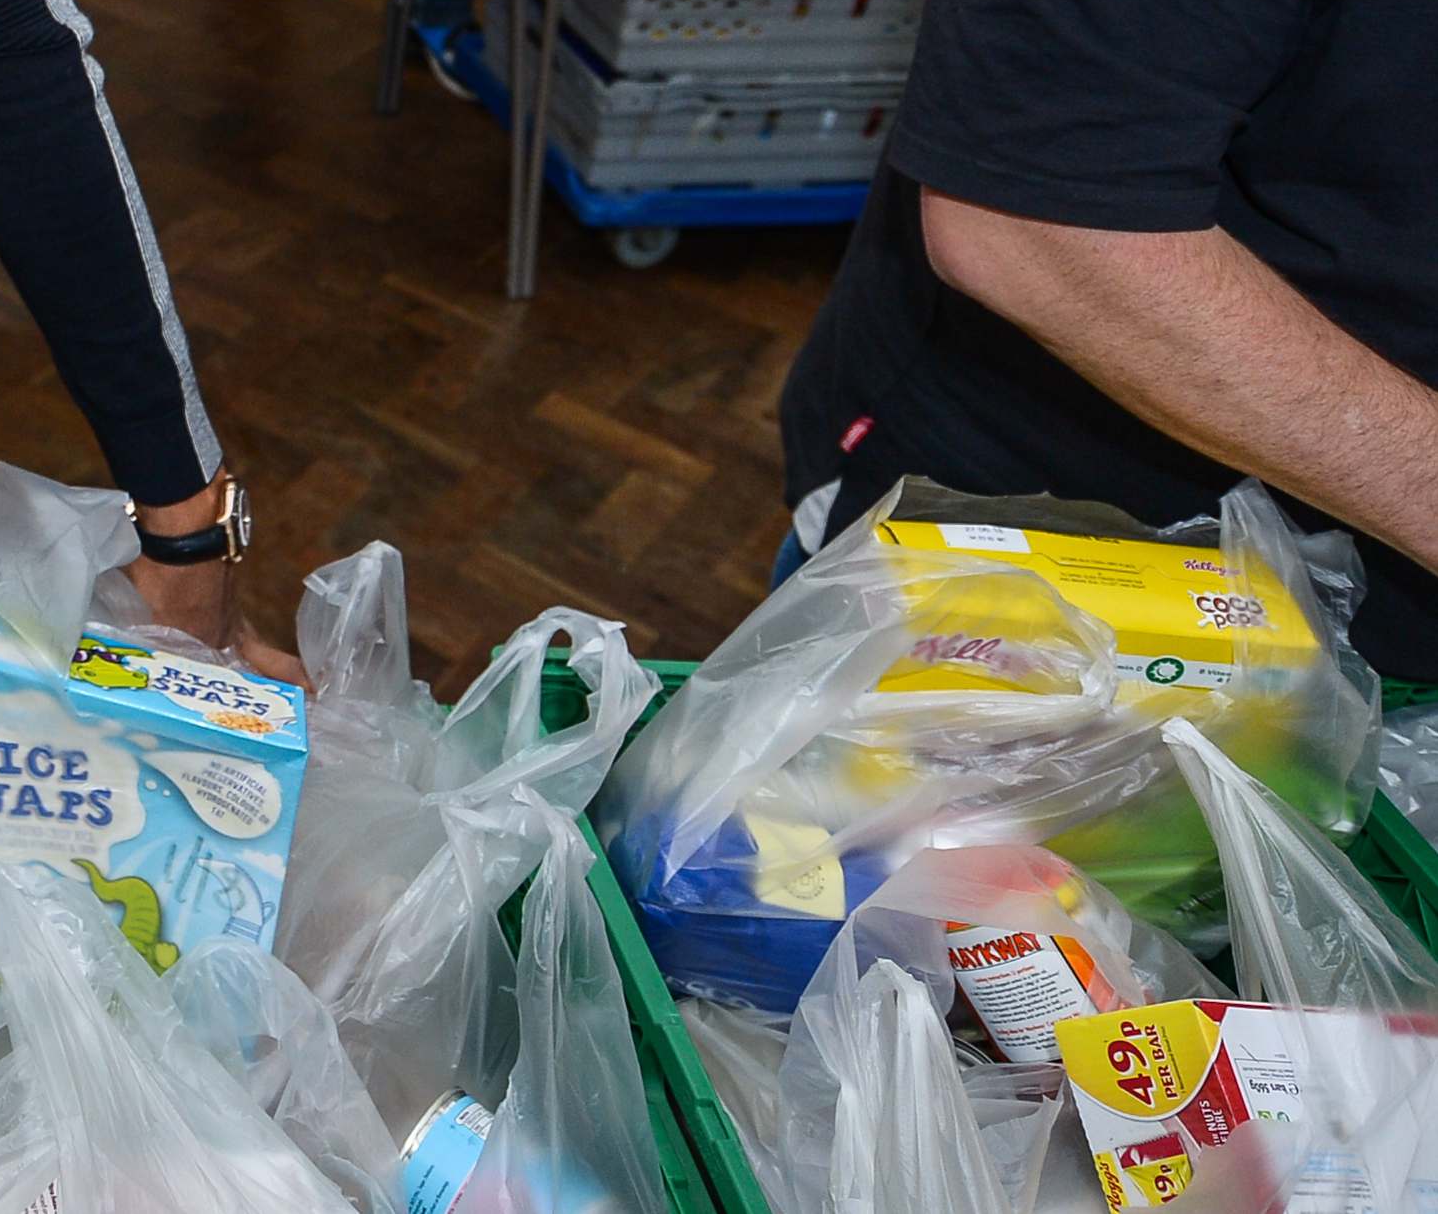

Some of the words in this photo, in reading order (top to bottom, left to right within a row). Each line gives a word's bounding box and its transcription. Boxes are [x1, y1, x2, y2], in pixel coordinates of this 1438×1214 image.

[1184, 559, 1241, 576] Kellog
[153, 676, 271, 716] SNAPS
[160, 666, 255, 700] RICE
[1144, 1024, 1166, 1061] BAR
[1108, 1021, 1154, 1106] 49p
[1157, 1065, 1179, 1099] PER
[1198, 1099, 1217, 1132] NUTS
